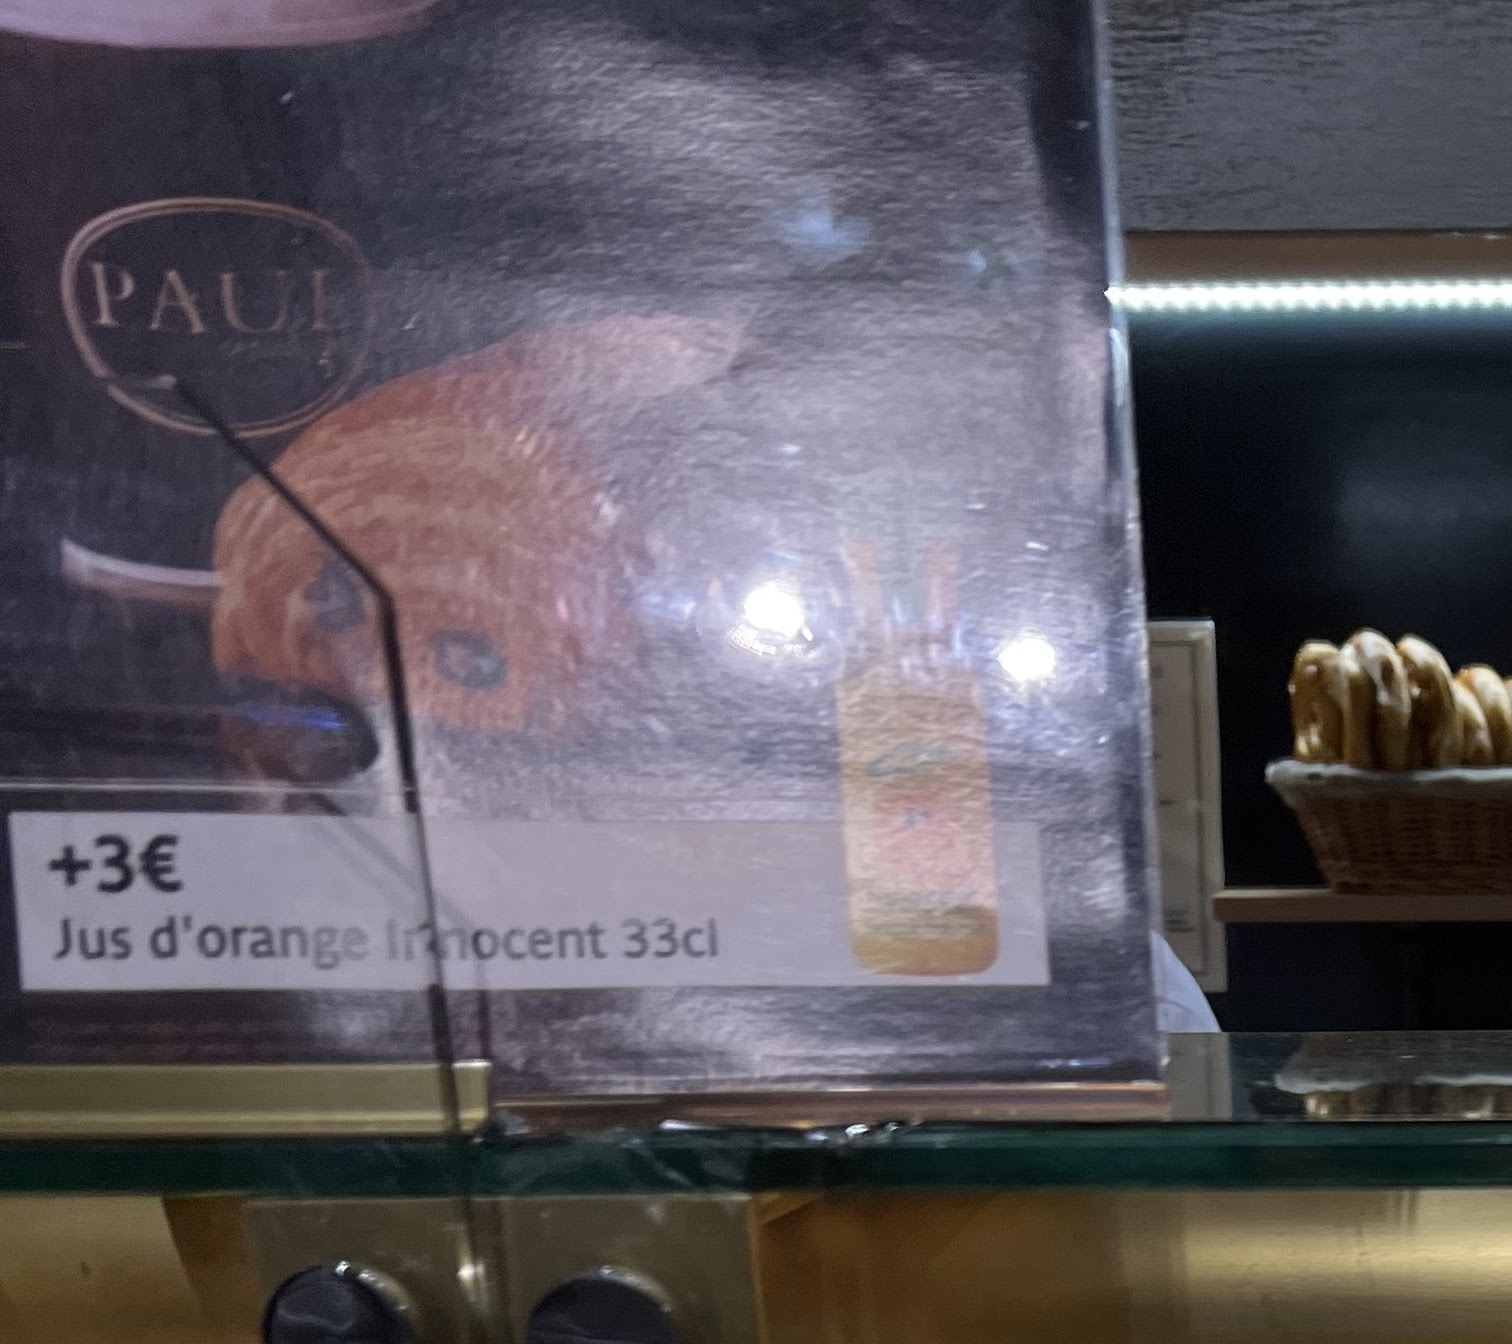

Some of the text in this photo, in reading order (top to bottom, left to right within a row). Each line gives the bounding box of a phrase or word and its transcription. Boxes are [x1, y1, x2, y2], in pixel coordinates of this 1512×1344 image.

[89, 260, 331, 334] PAUL
[49, 834, 183, 894] +3€
[53, 919, 131, 959] Jus
[149, 917, 368, 969] d'orange
[621, 919, 719, 959] 33cl
